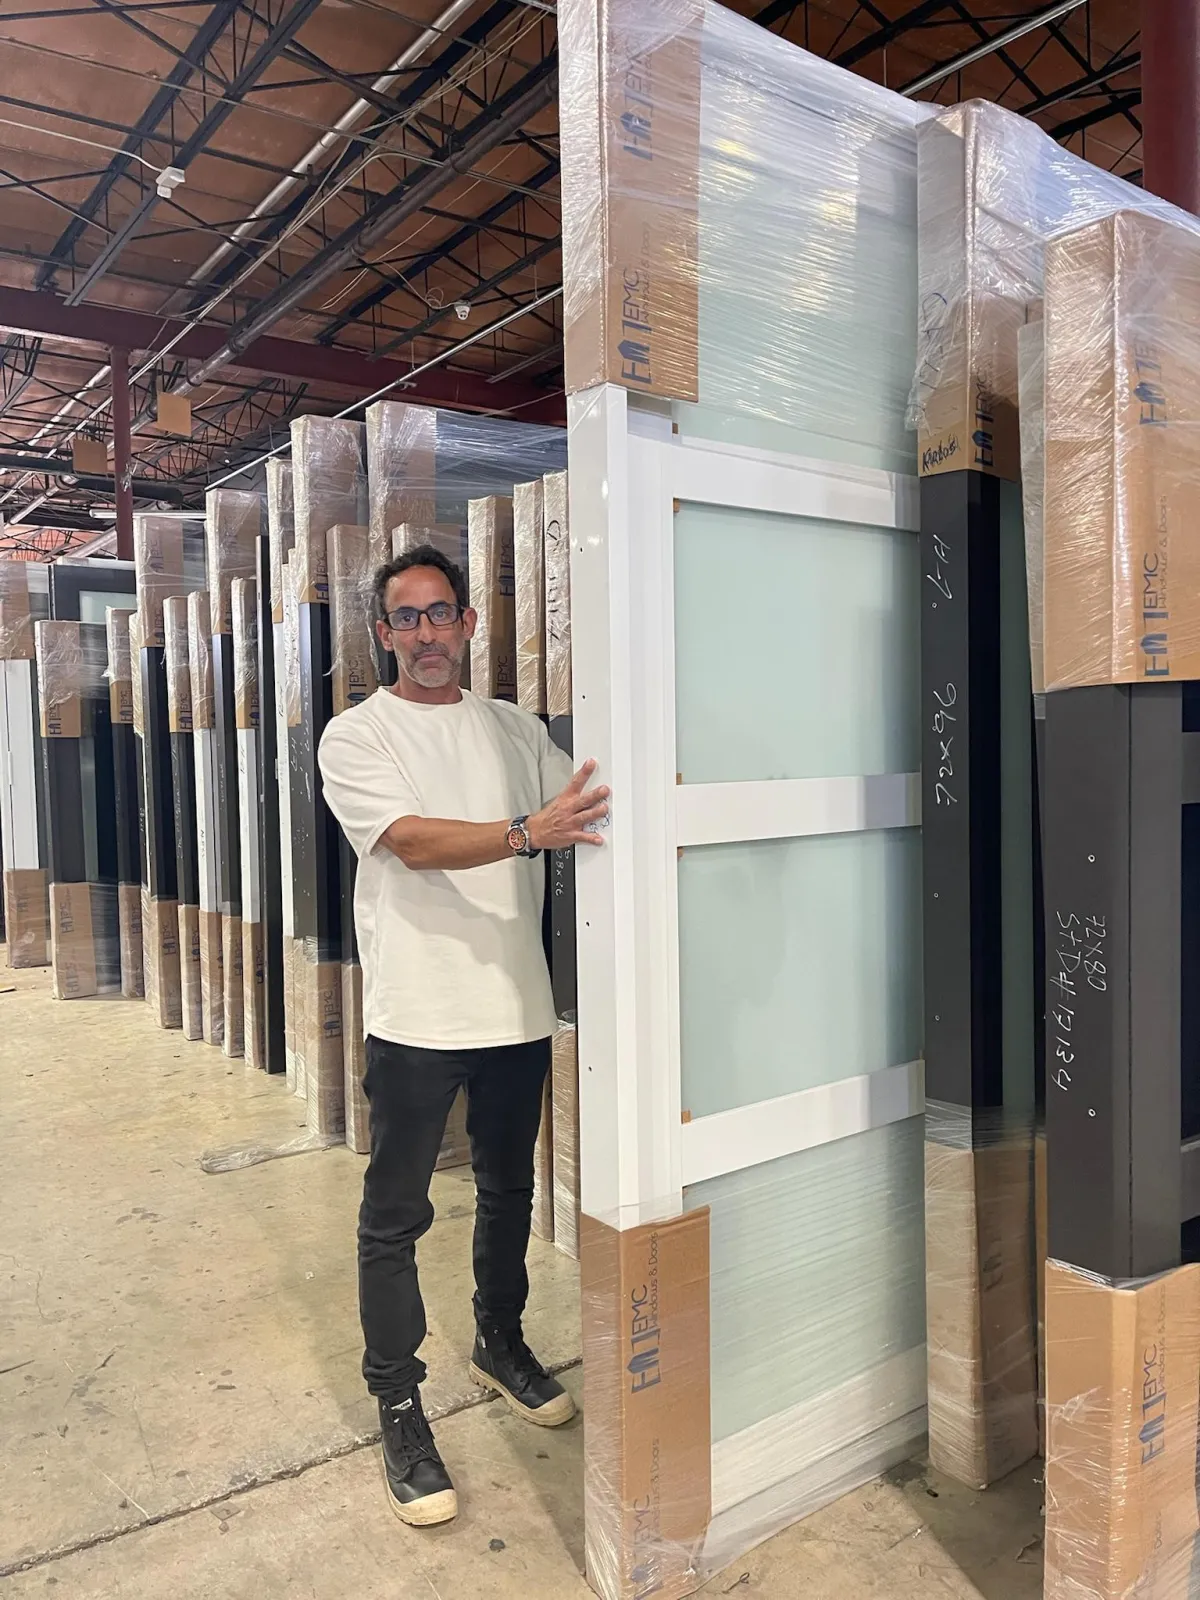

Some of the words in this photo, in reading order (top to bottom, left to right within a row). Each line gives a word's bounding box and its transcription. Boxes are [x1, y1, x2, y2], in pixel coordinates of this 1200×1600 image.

[623, 268, 639, 321] EMC
[1143, 552, 1158, 608] EMC
[648, 1232, 658, 1264] Doors
[649, 1268, 658, 1276] &
[631, 1284, 648, 1335] EMC
[648, 1279, 658, 1329] Windows
[1143, 1344, 1158, 1401] EMC
[633, 1494, 650, 1545] EMC
